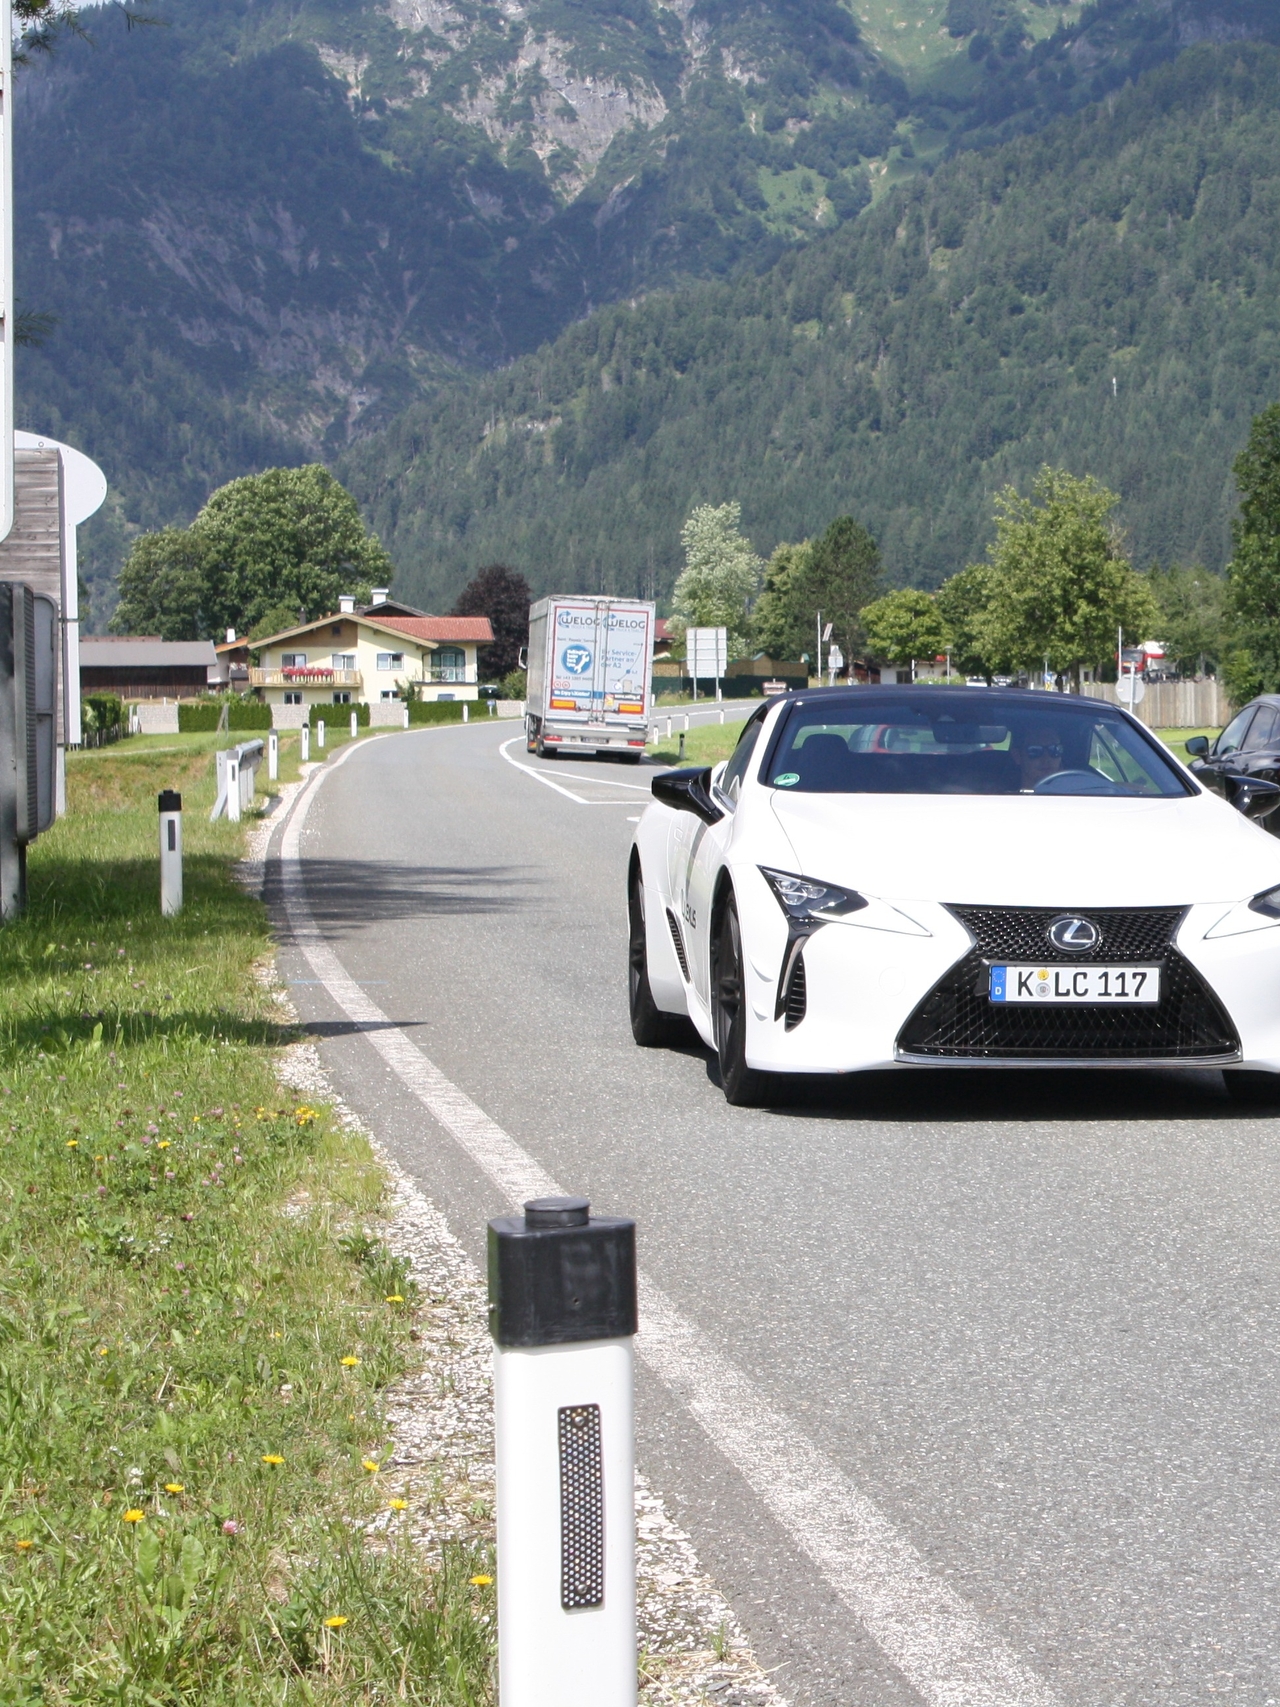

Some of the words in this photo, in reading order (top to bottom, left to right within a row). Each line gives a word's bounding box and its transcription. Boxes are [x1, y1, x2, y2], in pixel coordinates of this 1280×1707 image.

[561, 616, 601, 627] WELOG
[607, 618, 646, 629] WELOG
[1018, 971, 1035, 997] K
[1054, 971, 1088, 997] LC
[1098, 971, 1148, 998] 117
[995, 986, 1002, 996] D
